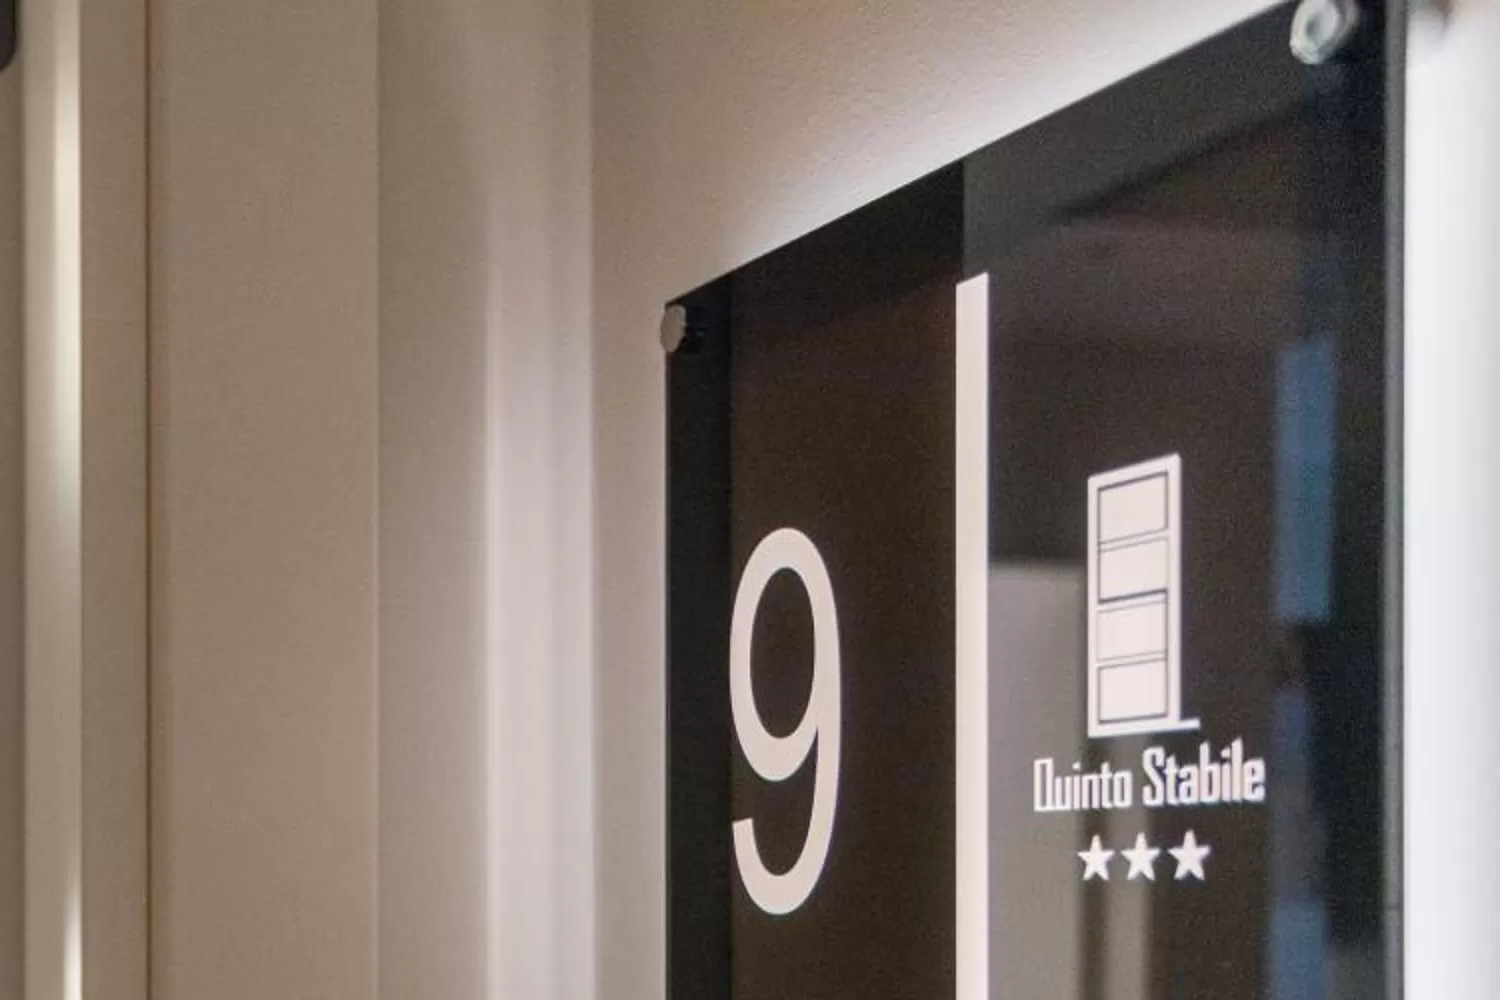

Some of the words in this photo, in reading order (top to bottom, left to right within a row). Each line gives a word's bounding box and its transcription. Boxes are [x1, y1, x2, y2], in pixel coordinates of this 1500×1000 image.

[730, 527, 842, 915] 9
[1033, 756, 1134, 813] Quinto
[1142, 737, 1266, 807] Stabile
